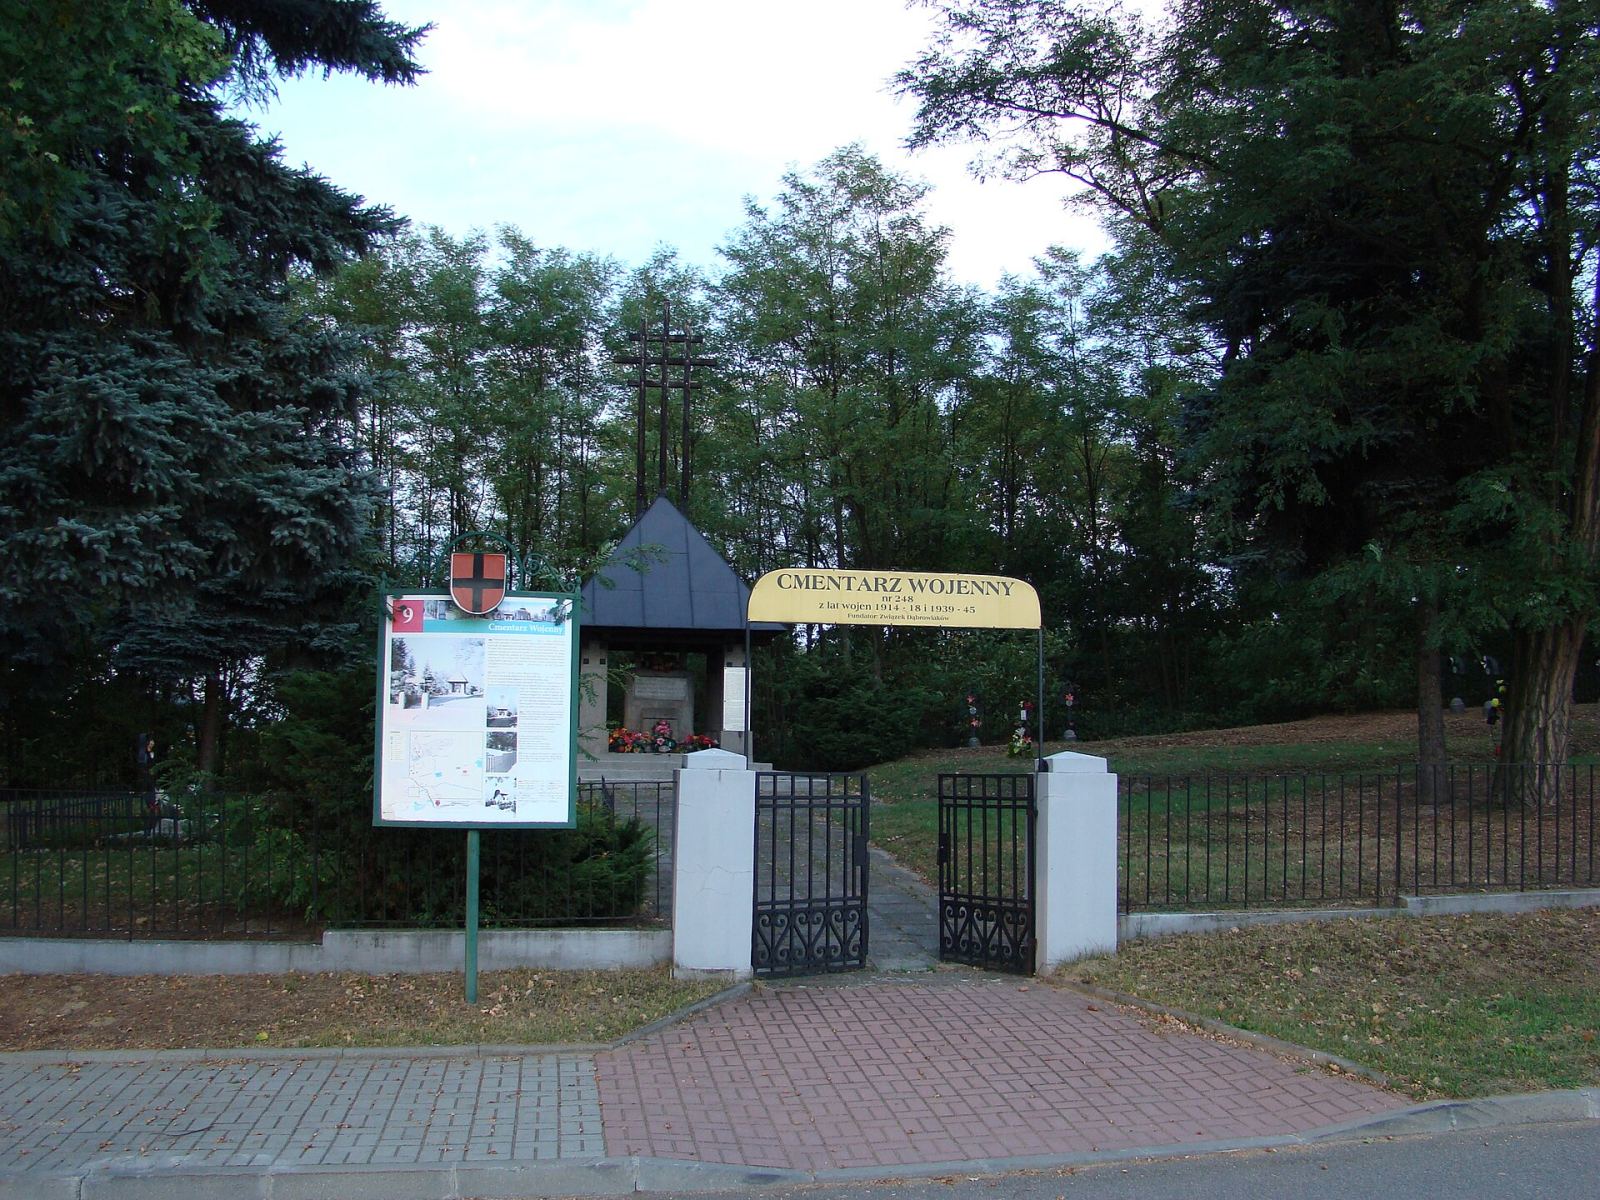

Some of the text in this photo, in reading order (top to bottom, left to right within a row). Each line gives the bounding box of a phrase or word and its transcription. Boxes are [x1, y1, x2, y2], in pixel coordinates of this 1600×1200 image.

[777, 573, 1015, 596] CMENTARZ WOJENNY
[827, 601, 840, 610] lat
[841, 602, 872, 612] wojen
[875, 603, 899, 611] 1914
[909, 604, 921, 612] 18
[924, 604, 927, 612] i
[931, 604, 955, 613] 1939
[963, 606, 976, 614] 45
[403, 607, 413, 624] 9
[489, 623, 563, 634] Cmentarz Wojenny
